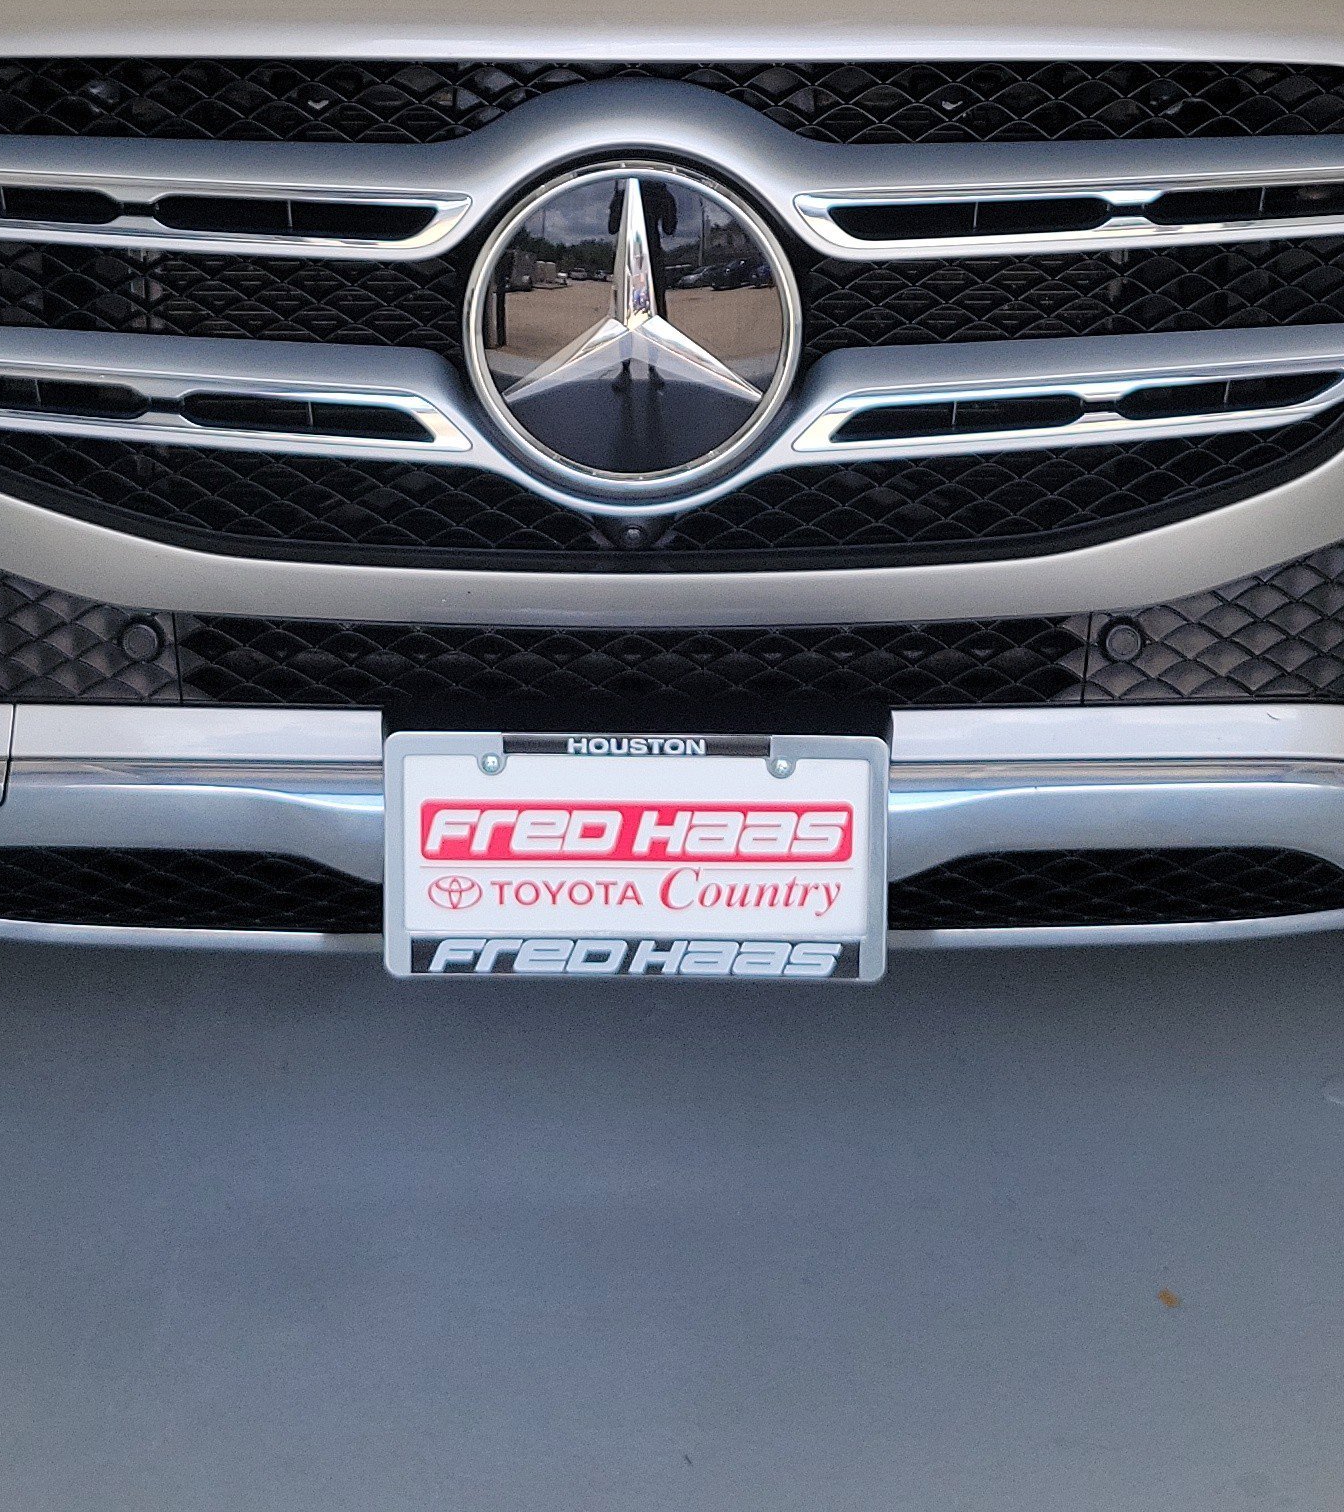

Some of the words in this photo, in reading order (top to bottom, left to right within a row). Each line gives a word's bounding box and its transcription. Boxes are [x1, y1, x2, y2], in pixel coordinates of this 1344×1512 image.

[567, 737, 706, 756] HOUSTON
[489, 879, 645, 907] TOYOTA
[658, 866, 843, 918] Country
